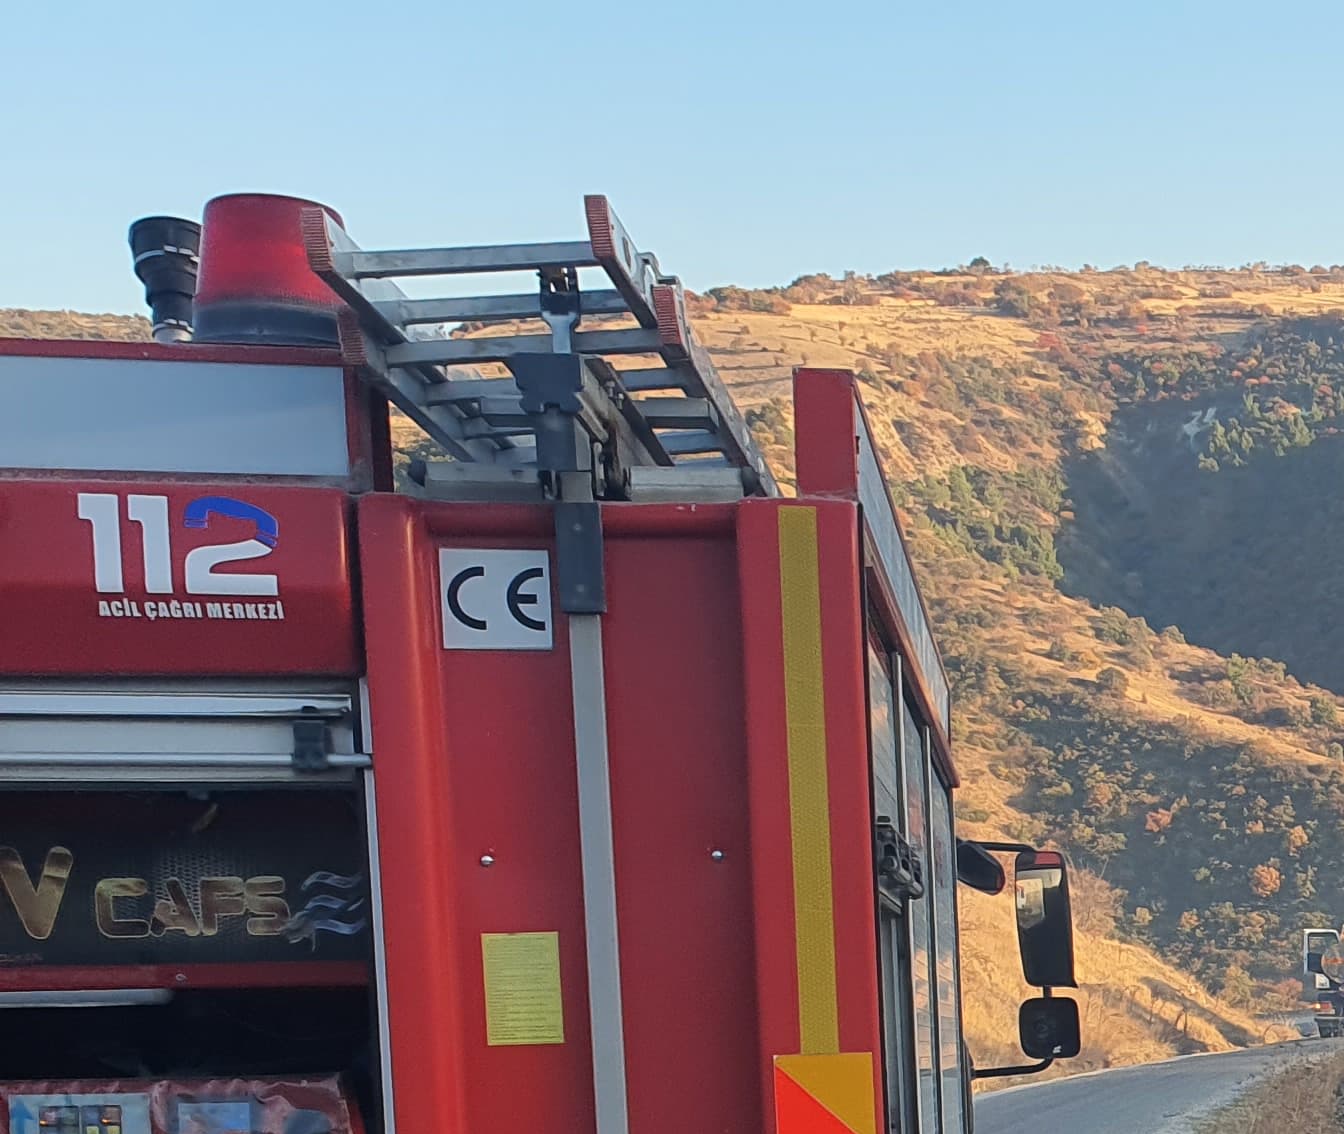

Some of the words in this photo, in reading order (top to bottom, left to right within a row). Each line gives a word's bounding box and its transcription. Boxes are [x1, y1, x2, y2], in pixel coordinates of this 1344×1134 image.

[77, 492, 279, 596] 112
[98, 597, 142, 617] ACİL
[143, 599, 203, 621] ÇAĞRI
[206, 600, 285, 620] MERKEZİ
[446, 566, 546, 631] CE
